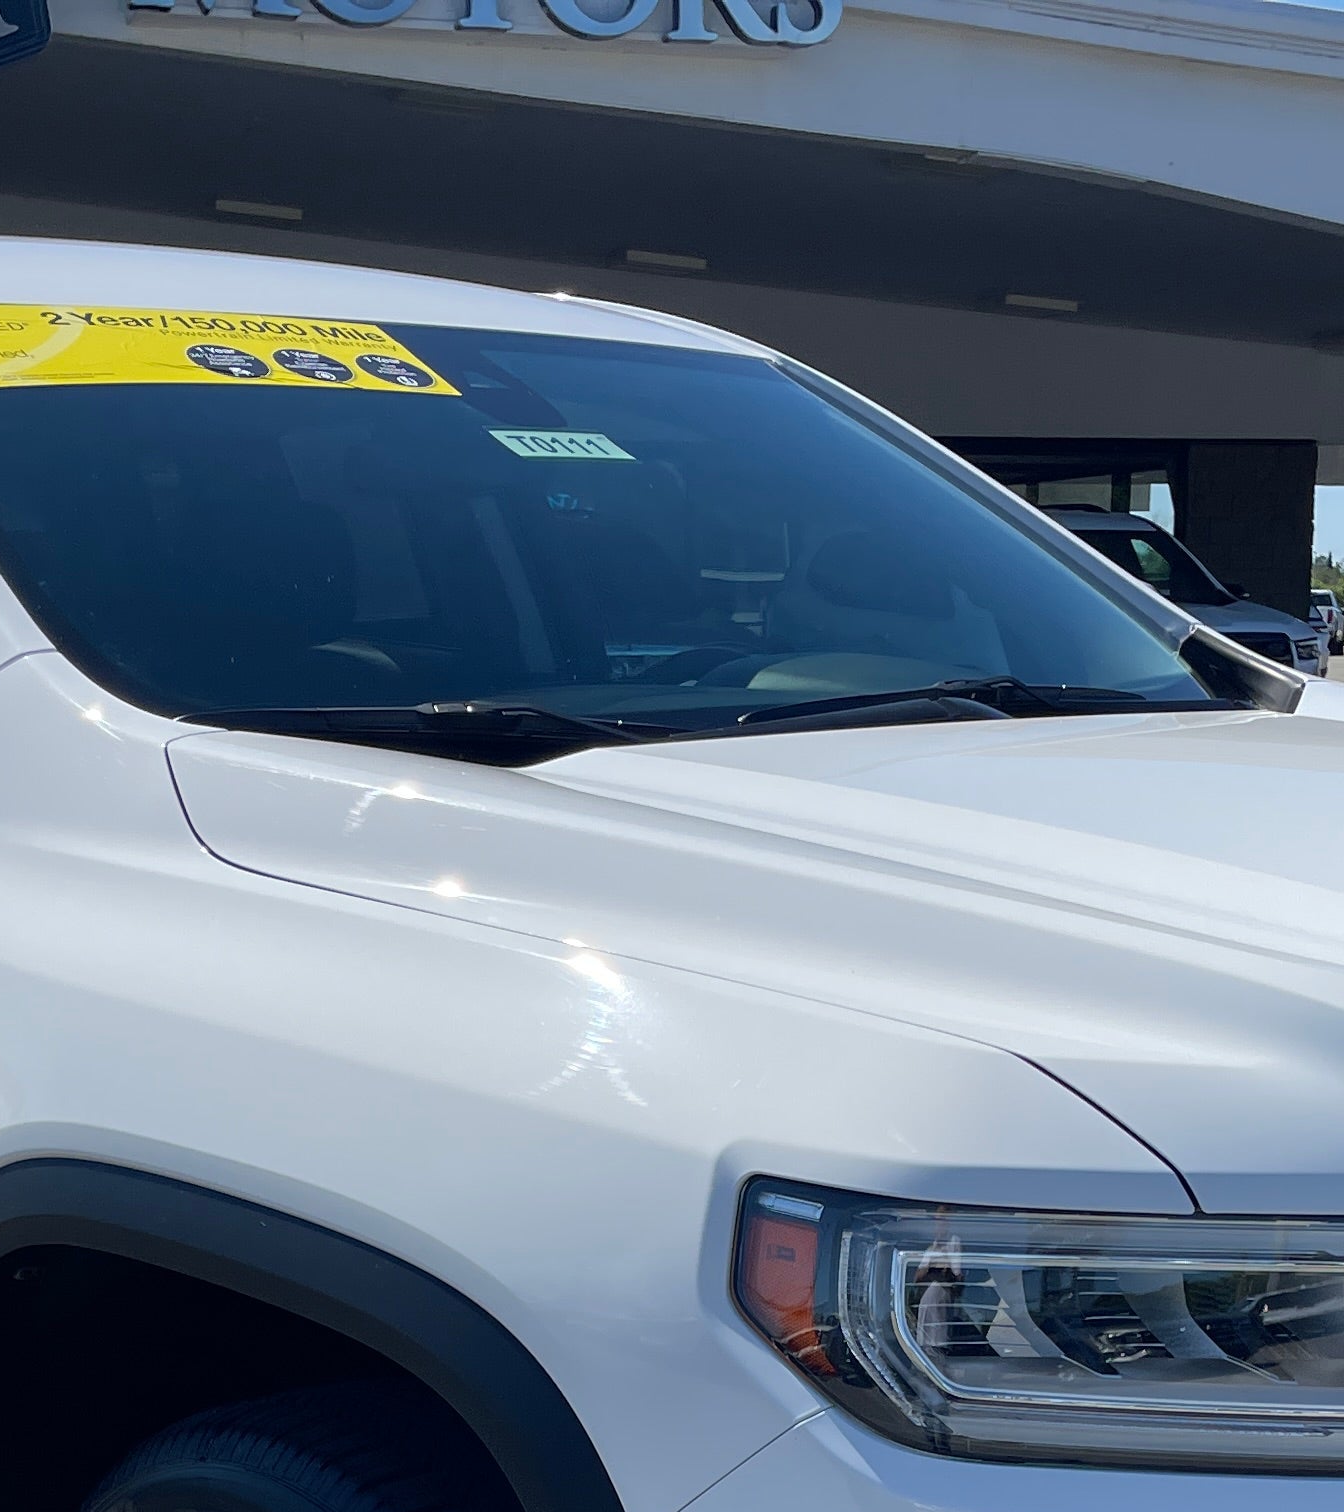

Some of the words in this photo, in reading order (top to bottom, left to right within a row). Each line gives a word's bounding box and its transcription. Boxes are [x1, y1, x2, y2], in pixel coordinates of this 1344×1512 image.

[39, 311, 72, 326] 2
[310, 324, 387, 343] Mile
[159, 328, 254, 342] Powertrain
[256, 333, 321, 346] Limited
[324, 339, 397, 352] Warranty
